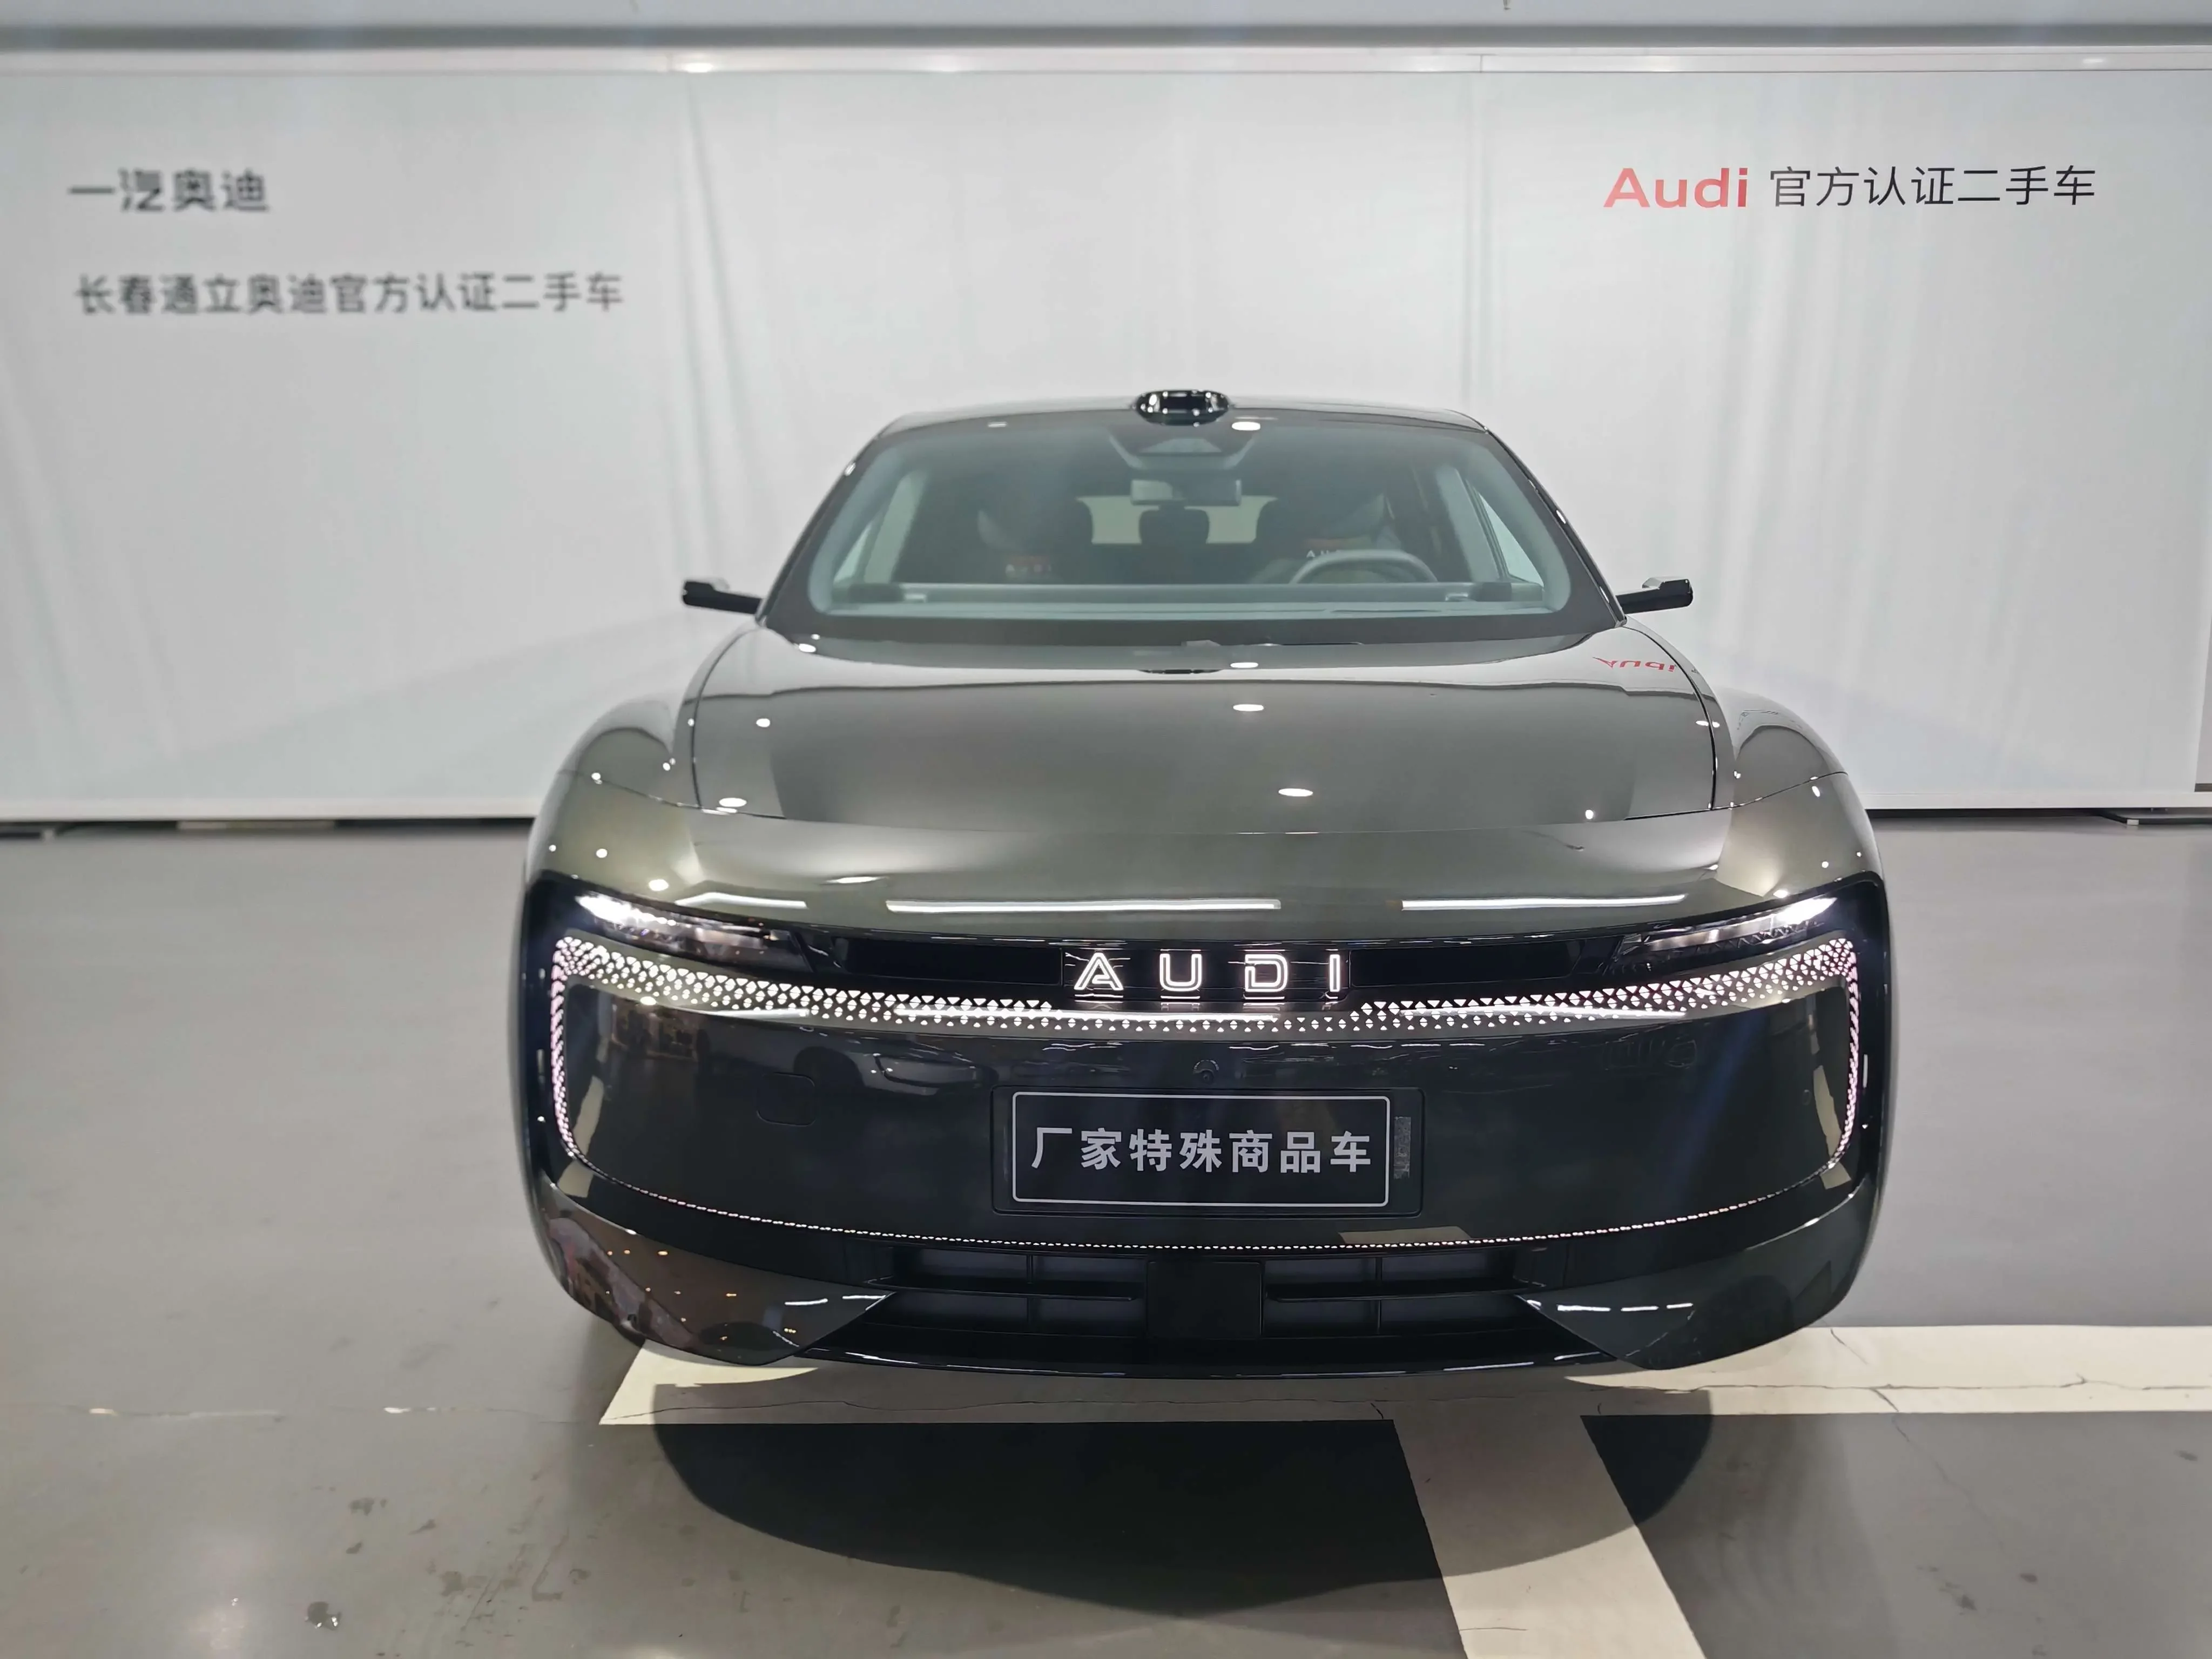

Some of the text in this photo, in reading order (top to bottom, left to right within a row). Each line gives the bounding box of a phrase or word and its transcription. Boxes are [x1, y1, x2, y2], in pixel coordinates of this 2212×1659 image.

[69, 169, 269, 212] 一汽奥迪
[1604, 165, 2096, 208] Audi 官方认证二手车
[76, 272, 623, 314] 长春通立奥迪官方认证二手车
[1074, 952, 1341, 992] AUDI
[1032, 1128, 1371, 1172] 厂家特殊商品车
